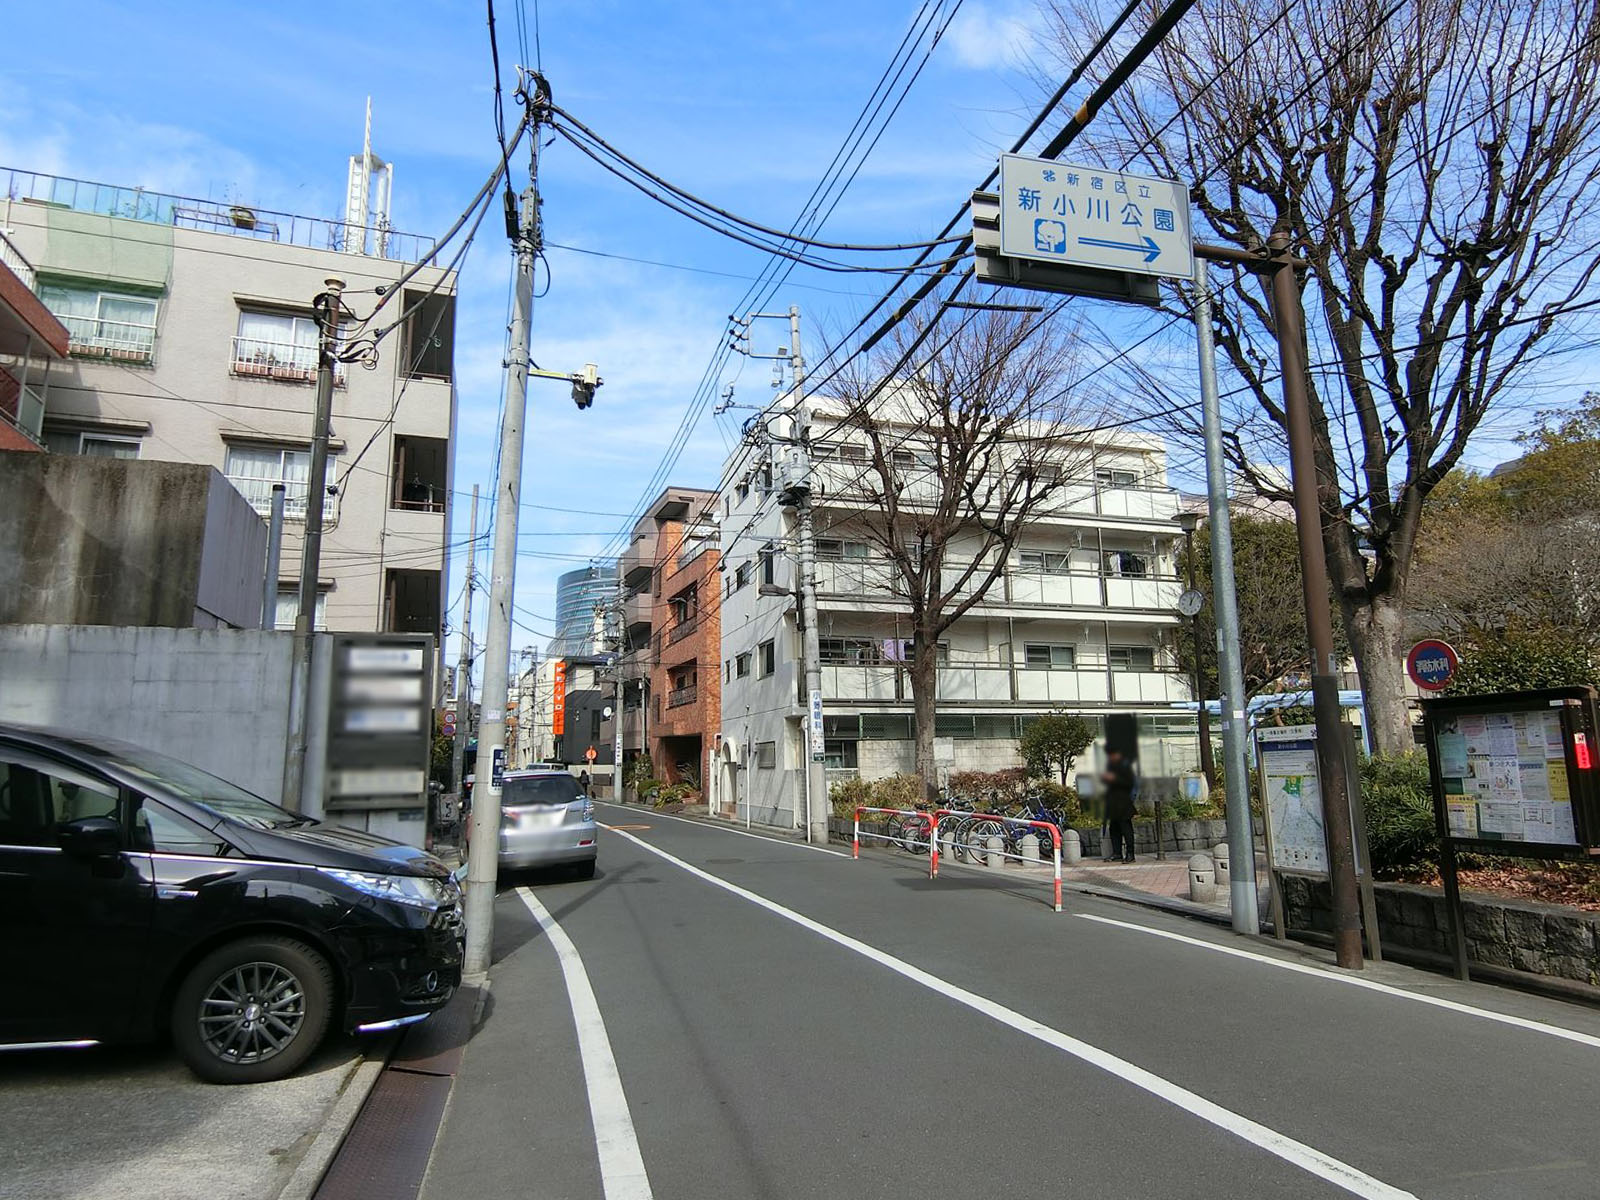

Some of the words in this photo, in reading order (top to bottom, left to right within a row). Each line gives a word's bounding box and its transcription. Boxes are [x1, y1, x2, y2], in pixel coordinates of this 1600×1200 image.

[1066, 172, 1152, 199] 新宿区立
[1018, 186, 1175, 232] 新小川公園
[1415, 657, 1449, 674] 消防水利
